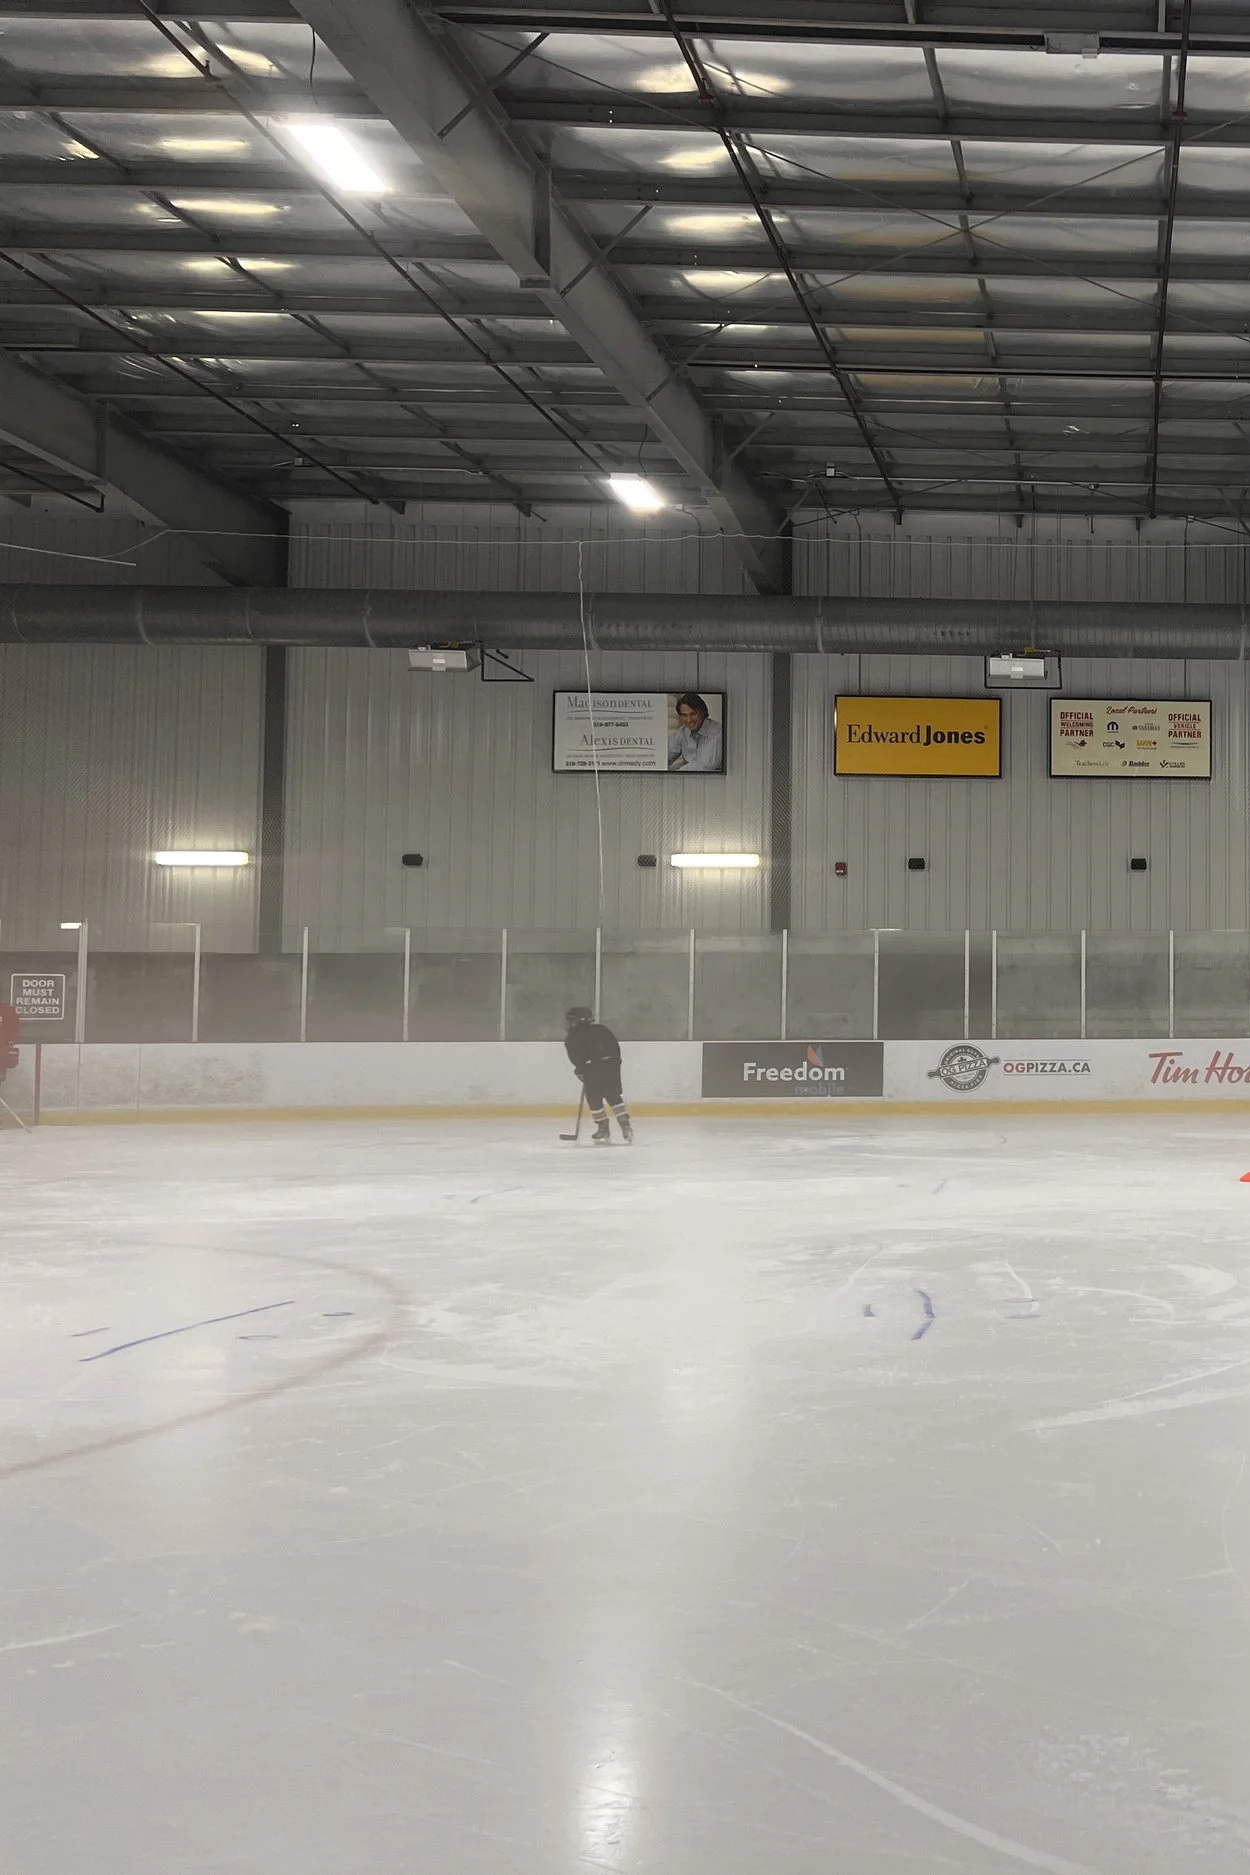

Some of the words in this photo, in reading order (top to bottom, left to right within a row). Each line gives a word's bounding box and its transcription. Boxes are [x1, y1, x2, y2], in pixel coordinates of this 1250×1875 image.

[1106, 706, 1127, 714] Local
[1060, 711, 1094, 720] OFFICIAL
[1168, 713, 1202, 722] OFFICIAL
[1060, 729, 1094, 737] PARTNER
[1168, 730, 1202, 738] PARTNER
[22, 988, 54, 996] MUST
[16, 997, 60, 1005] REMAIN
[15, 1006, 60, 1014] CLOSED
[743, 1061, 845, 1081] Freedom
[941, 1065, 957, 1076] OG
[958, 1059, 988, 1073] PIZZA
[1003, 1062, 1092, 1073] OGPIZZA.CA
[1148, 1051, 1199, 1084] Tim
